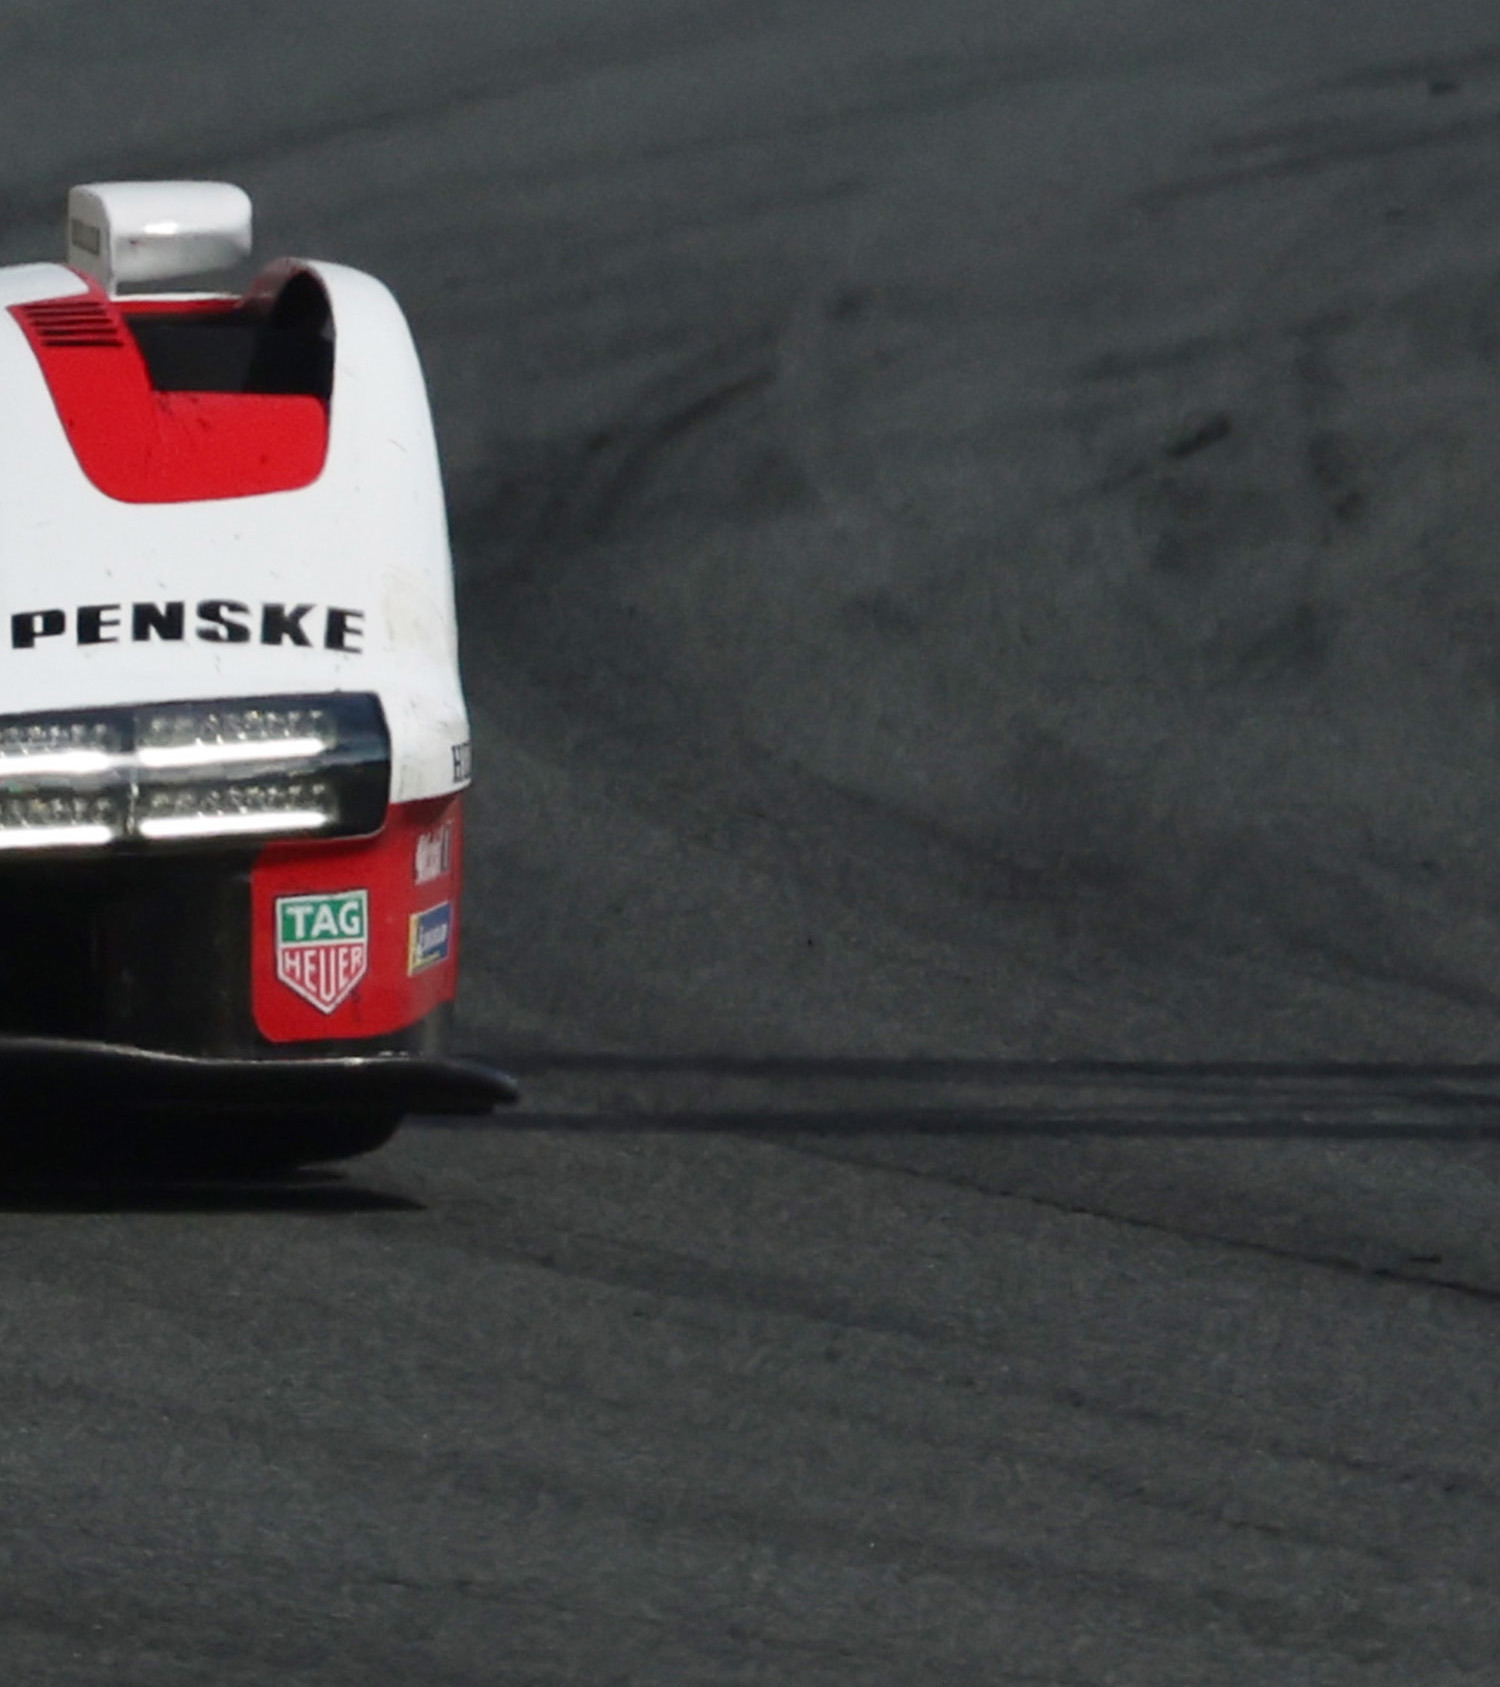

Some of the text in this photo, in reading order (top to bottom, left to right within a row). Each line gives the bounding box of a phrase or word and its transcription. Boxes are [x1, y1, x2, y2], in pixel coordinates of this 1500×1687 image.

[10, 598, 366, 654] PENSKE
[286, 900, 361, 941] TAG
[283, 945, 363, 1002] HEUER
